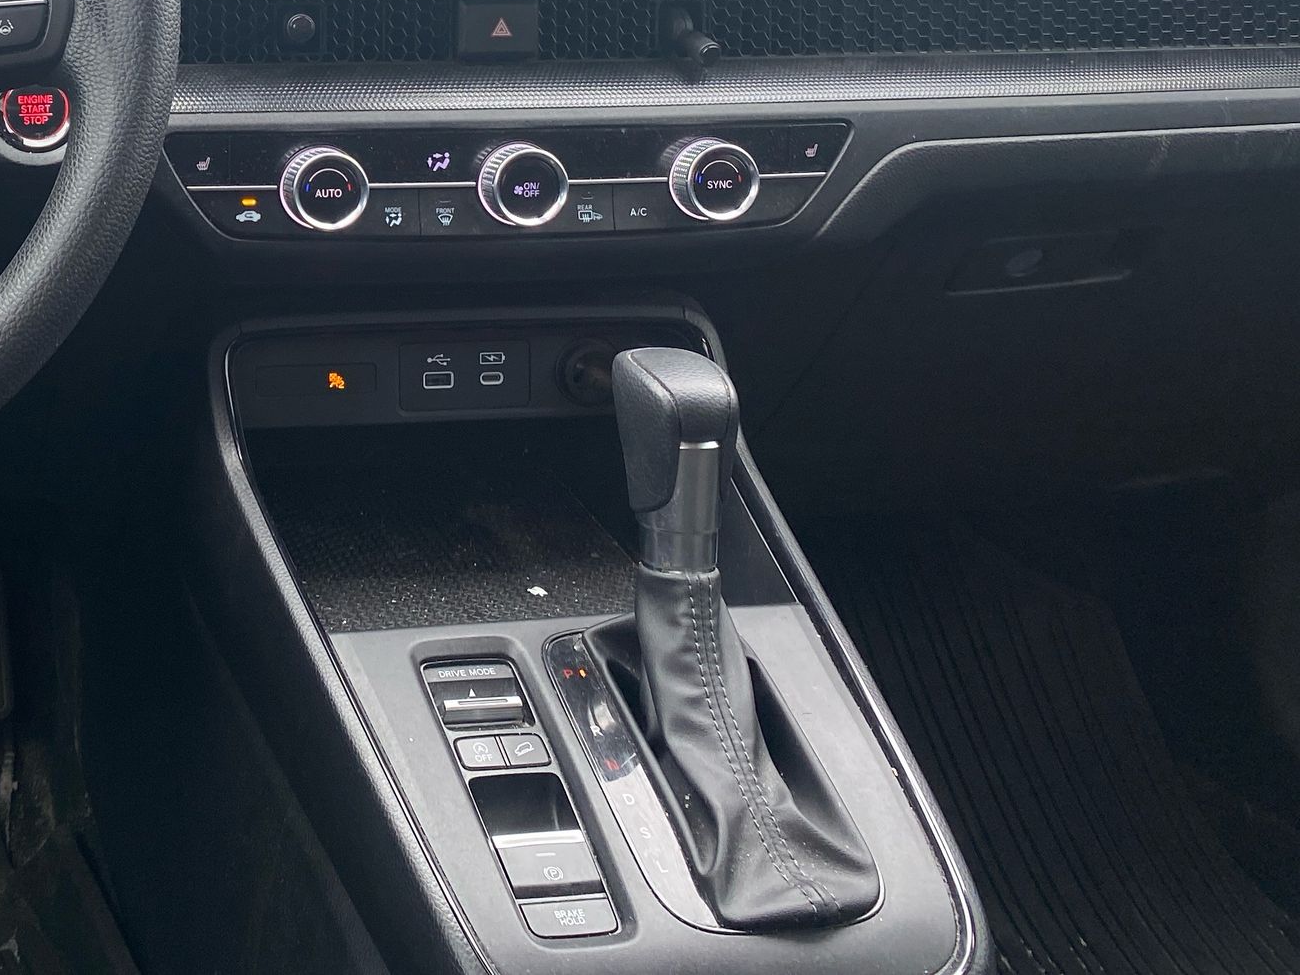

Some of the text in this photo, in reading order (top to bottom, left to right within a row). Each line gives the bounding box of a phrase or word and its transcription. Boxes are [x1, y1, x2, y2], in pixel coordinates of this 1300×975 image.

[17, 94, 54, 104] ENGINE
[20, 104, 51, 114] START
[23, 115, 49, 126] STOP
[706, 179, 733, 189] SYNC
[314, 188, 343, 199] AUTO
[523, 190, 540, 198] OFF
[630, 207, 648, 217] A/C
[437, 667, 497, 678] DRIVE MODE
[590, 724, 604, 737] R
[474, 753, 493, 763] OFF
[622, 793, 636, 806] D
[639, 826, 653, 840] S
[554, 907, 586, 919] BRAKE
[558, 916, 586, 927] HOLD
